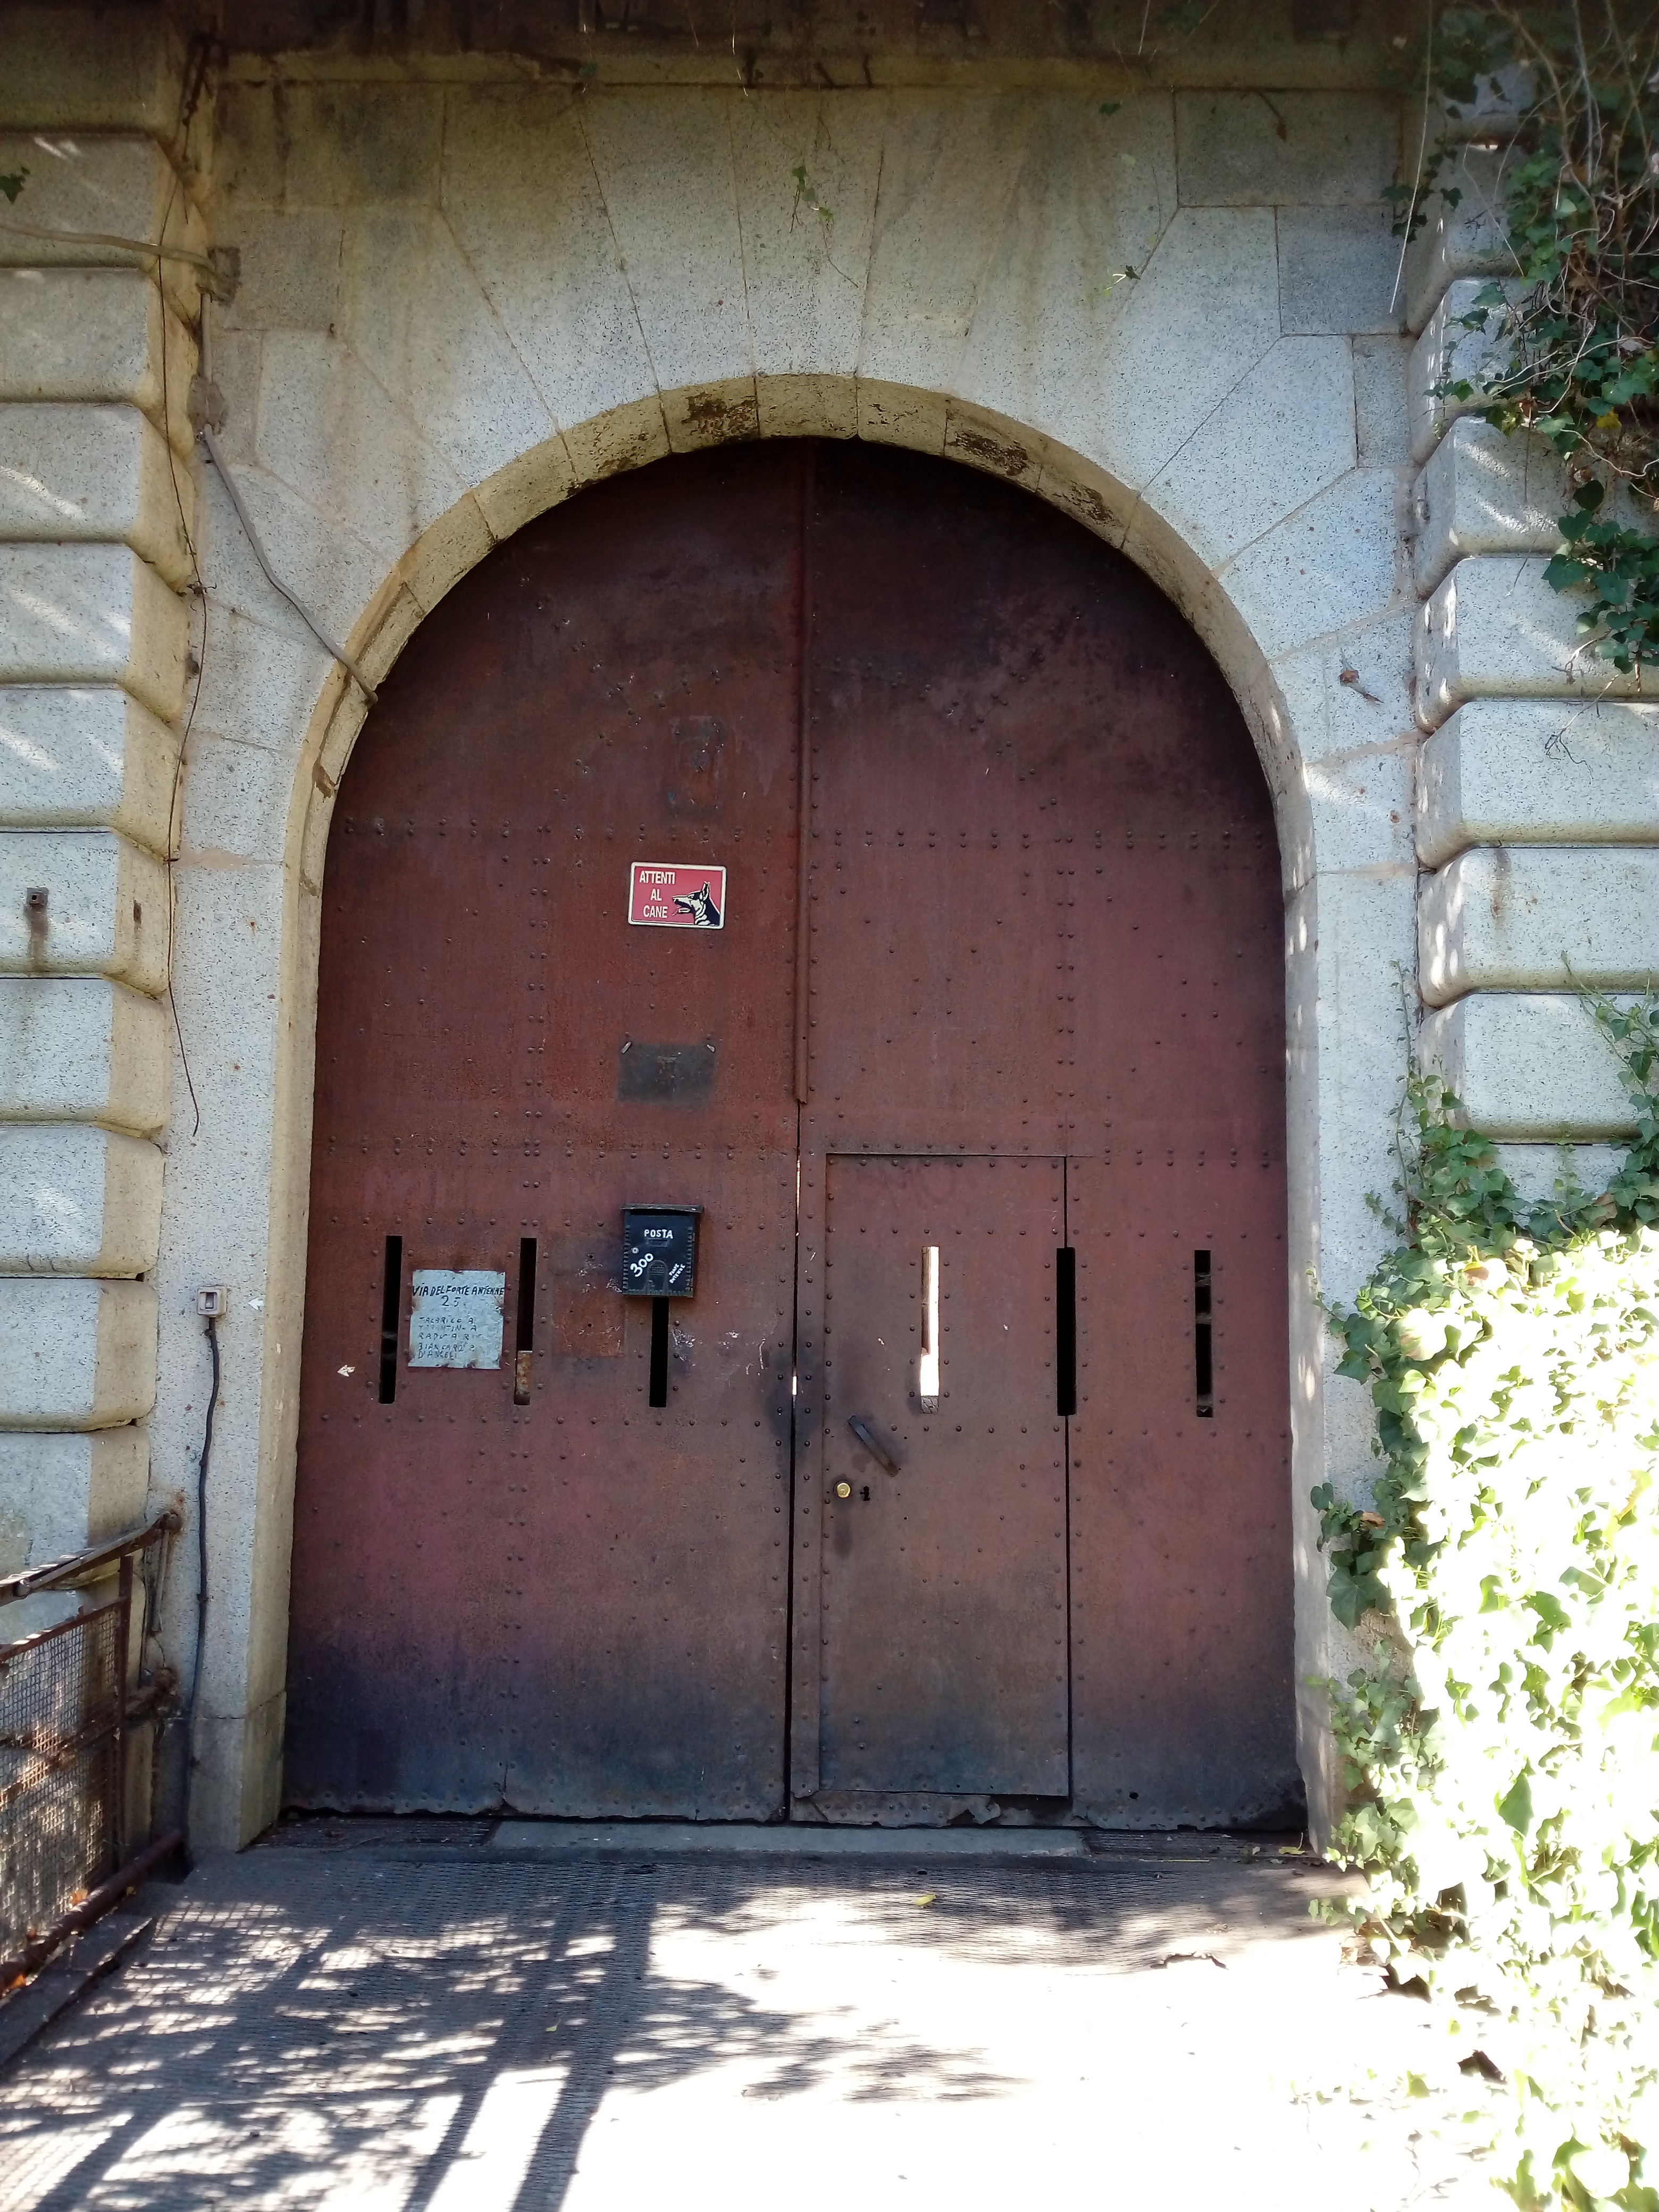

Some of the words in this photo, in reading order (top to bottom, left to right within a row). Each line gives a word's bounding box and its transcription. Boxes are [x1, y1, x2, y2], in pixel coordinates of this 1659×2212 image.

[639, 870, 675, 884] ATTENTI
[650, 889, 662, 901] AL
[643, 905, 668, 918] CANE
[644, 1229, 673, 1239] POSTA
[630, 1253, 653, 1277] 300
[412, 1285, 429, 1296] VIA
